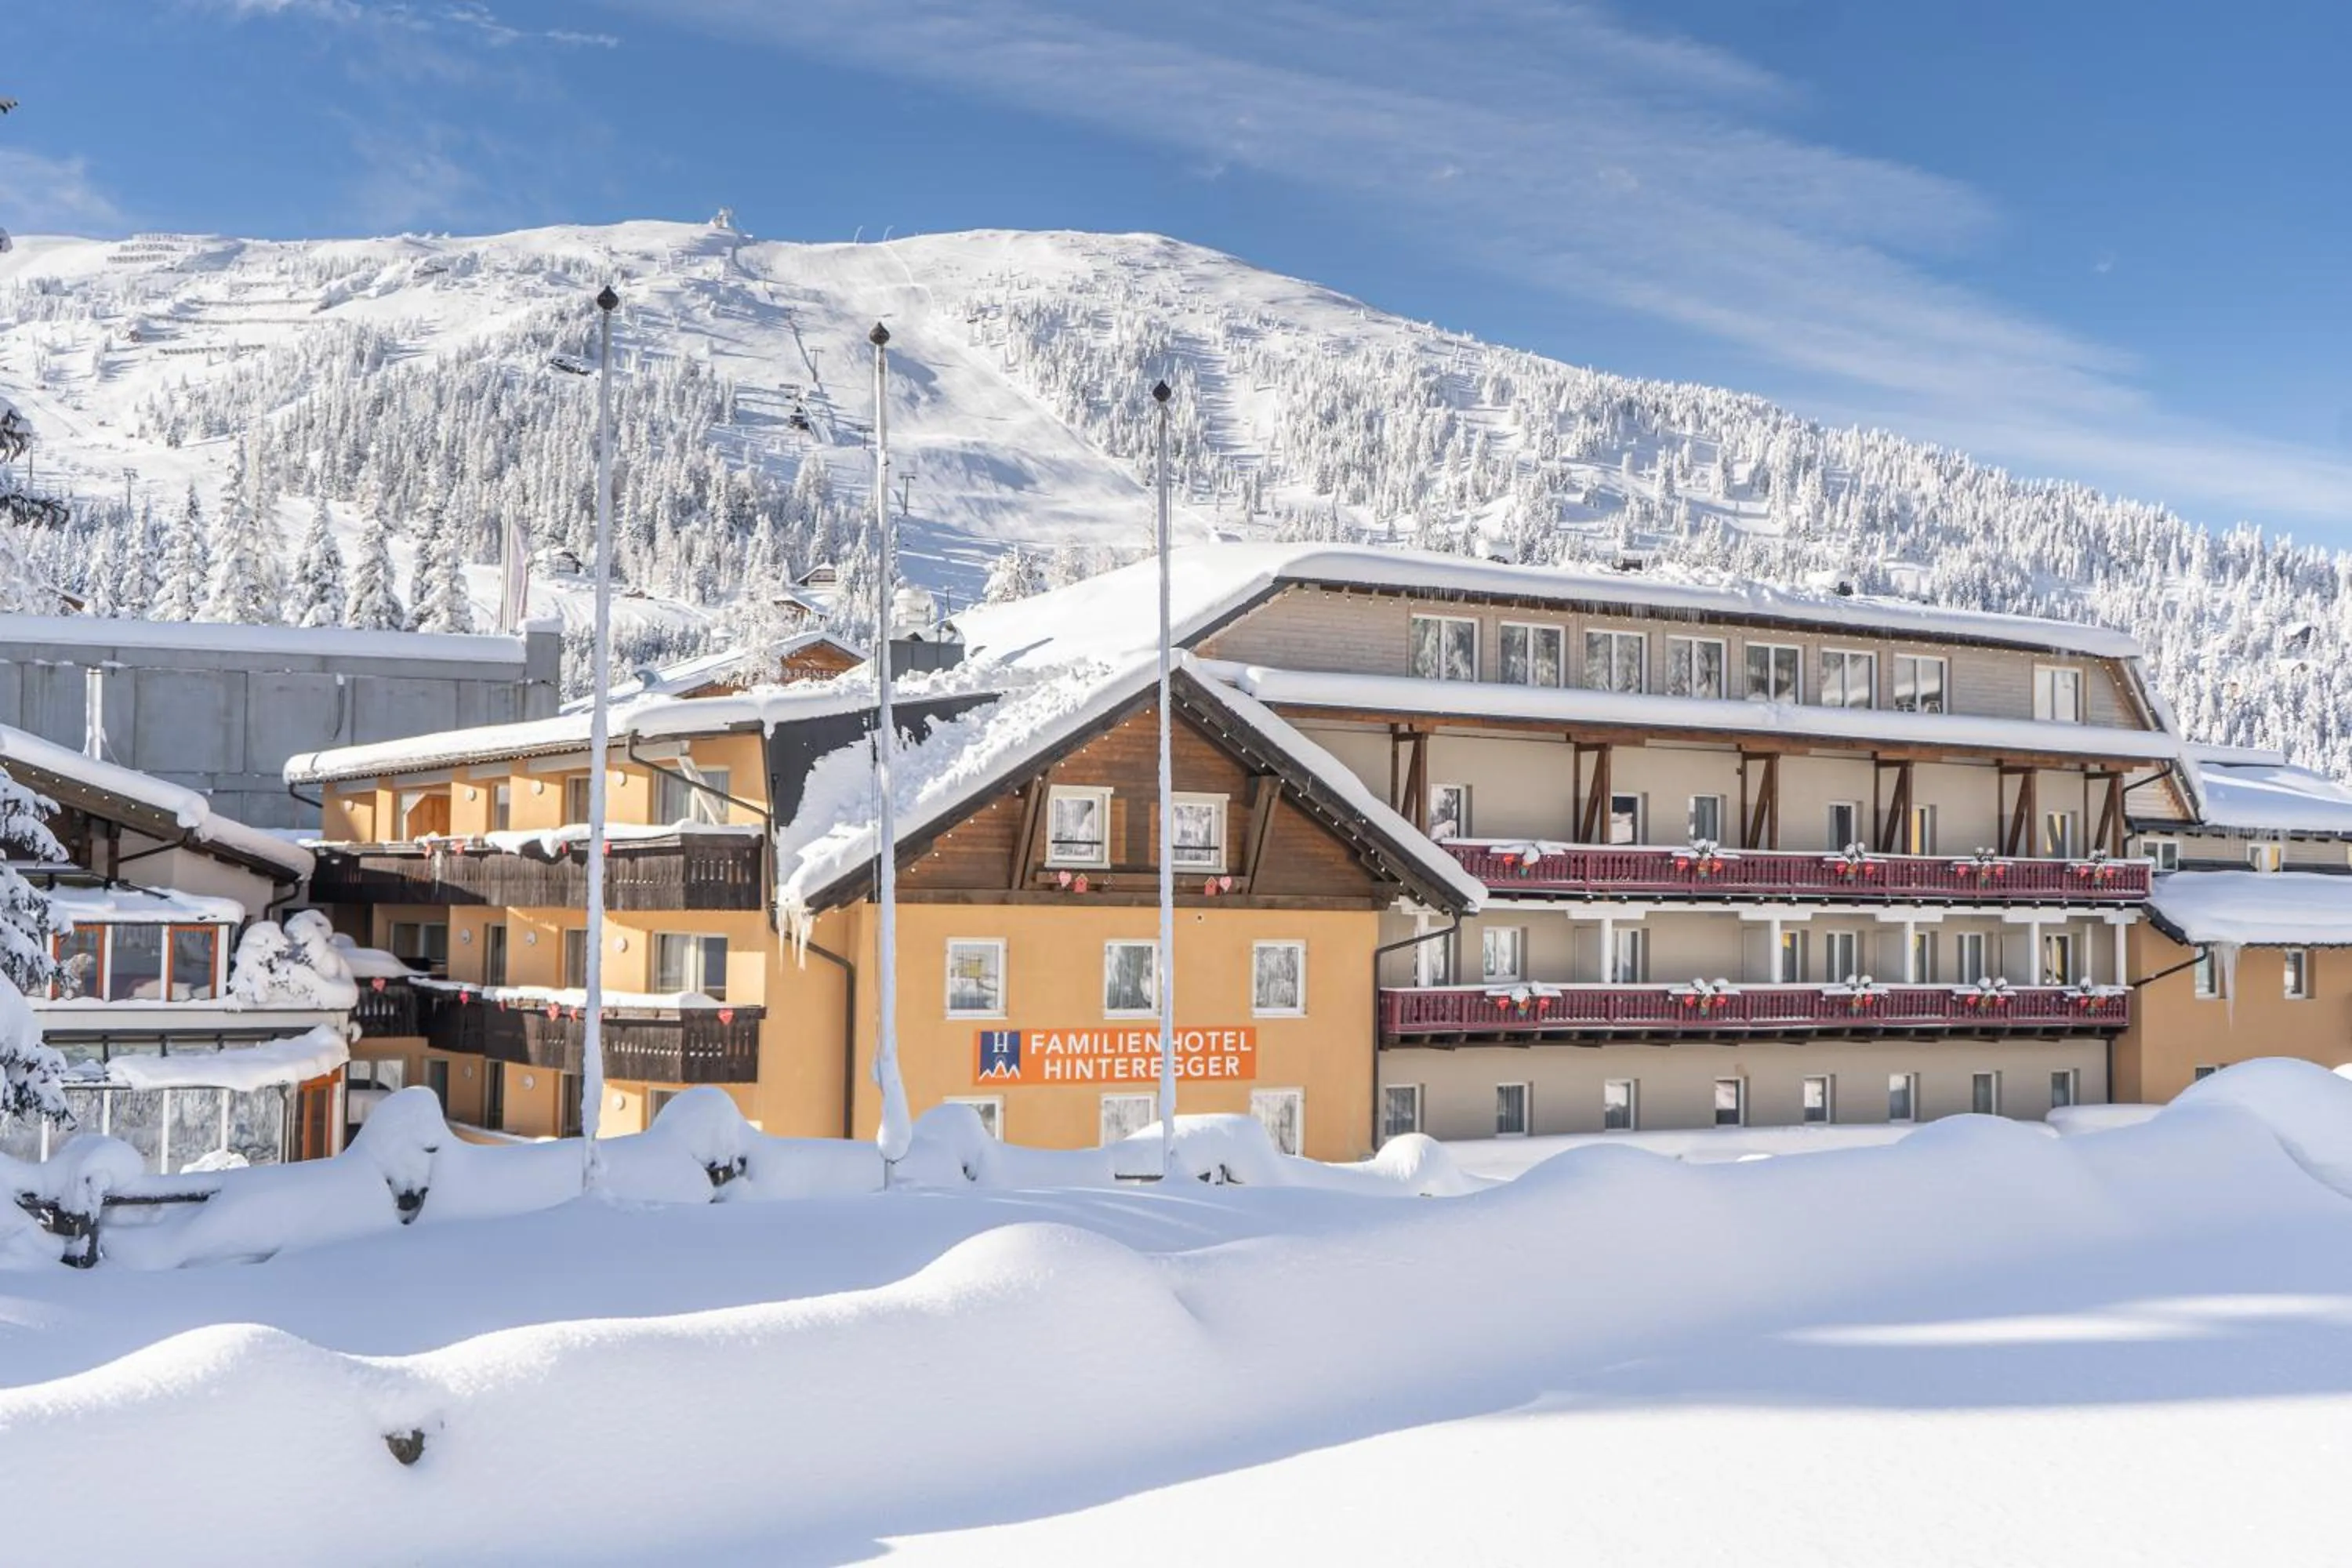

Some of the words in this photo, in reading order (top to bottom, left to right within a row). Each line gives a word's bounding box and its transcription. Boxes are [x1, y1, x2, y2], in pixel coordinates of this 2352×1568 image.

[993, 1031, 1009, 1052] H
[1030, 1031, 1252, 1054] FAMILIENHOTEL
[1044, 1055, 1241, 1080] HINTEREGGER
